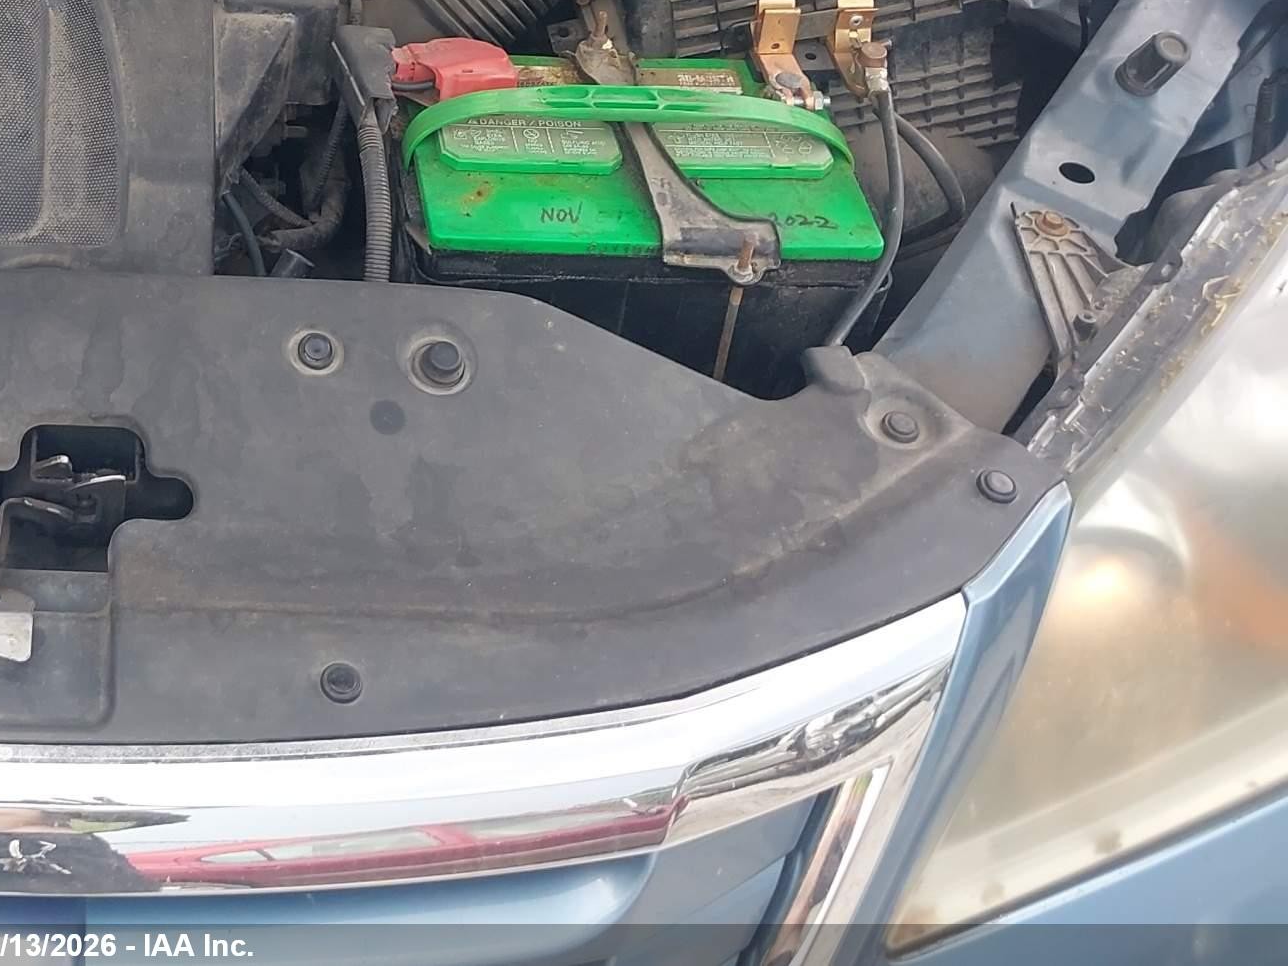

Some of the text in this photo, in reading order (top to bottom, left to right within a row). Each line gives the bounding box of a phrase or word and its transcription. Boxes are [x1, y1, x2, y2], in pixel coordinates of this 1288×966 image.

[479, 118, 527, 126] DANGER
[538, 119, 582, 127] POISON
[540, 201, 584, 224] NOV
